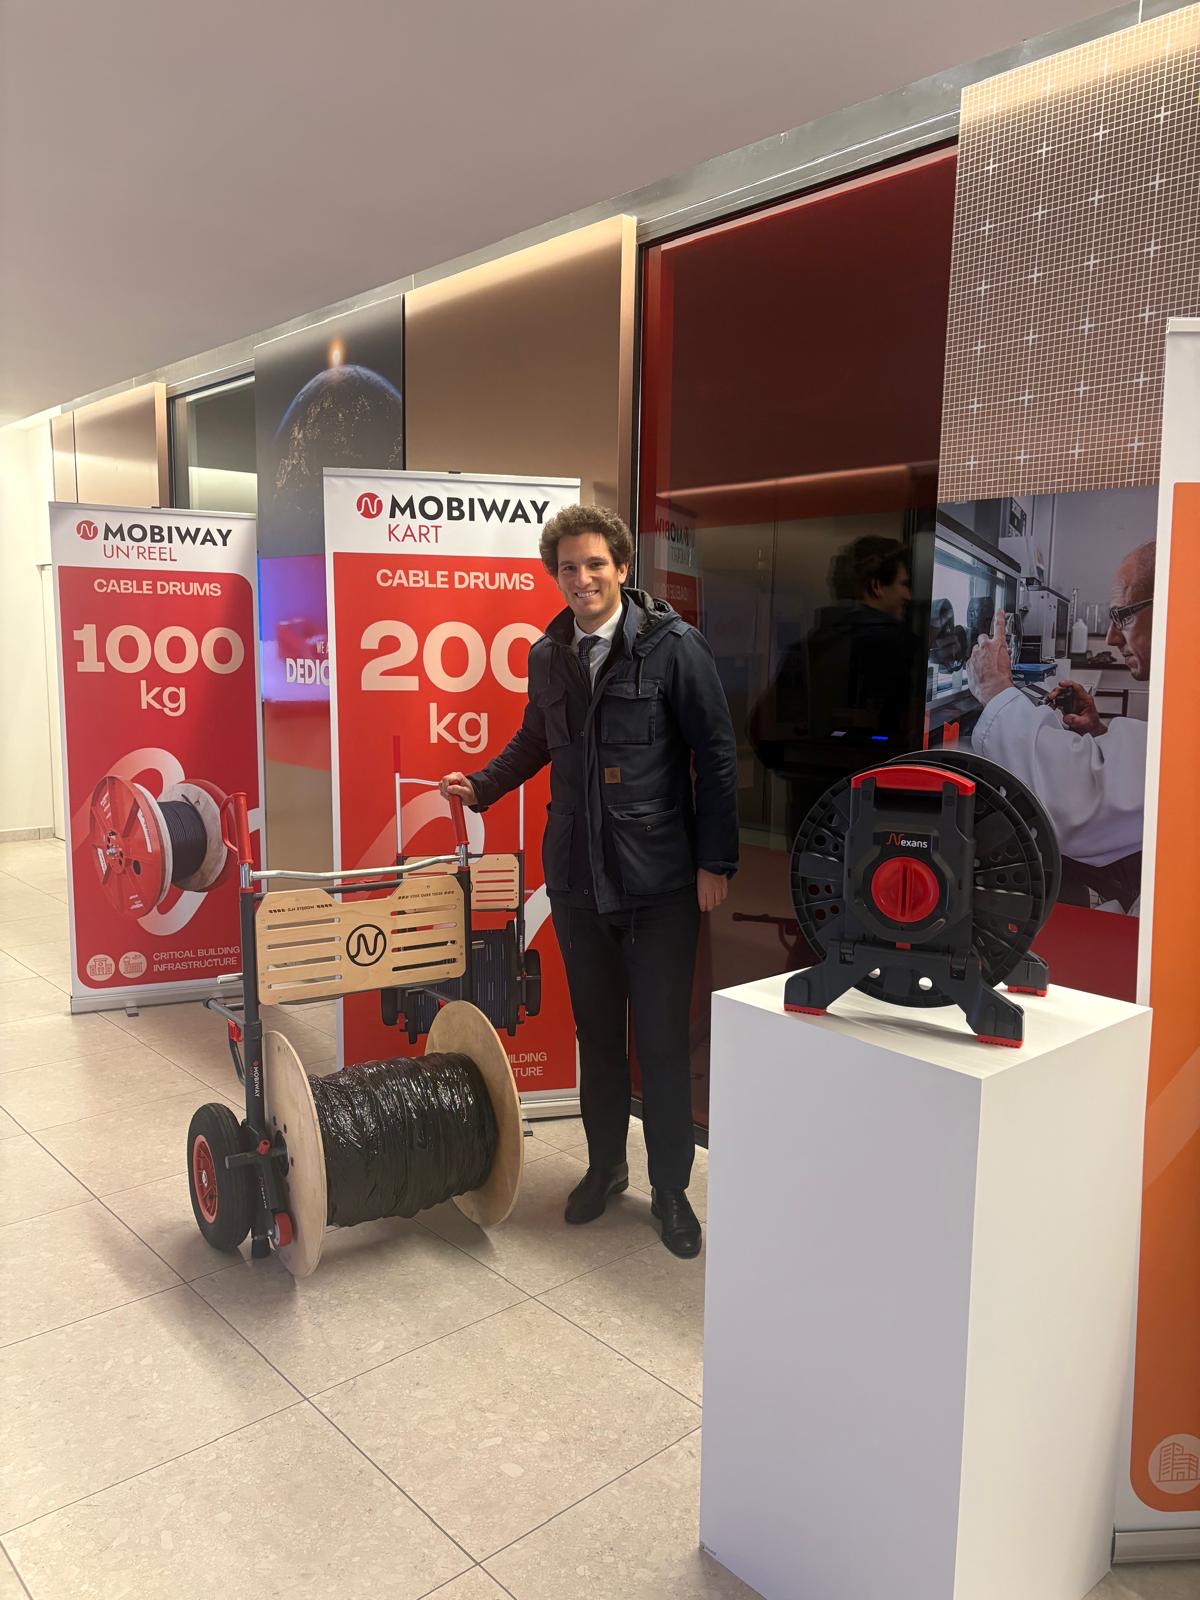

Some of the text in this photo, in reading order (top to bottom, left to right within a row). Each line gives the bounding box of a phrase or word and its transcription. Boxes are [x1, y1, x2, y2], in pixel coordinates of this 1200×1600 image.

[388, 494, 550, 524] MOBIWAY
[103, 522, 232, 547] MOBIWAY
[388, 523, 443, 543] KART
[103, 544, 177, 561] UN'REEL
[93, 579, 222, 596] CABLE DRUMS
[376, 568, 535, 591] CABLE DRUMS
[73, 623, 245, 675] 1000
[360, 619, 546, 693] 200
[140, 679, 186, 717] kg
[429, 702, 489, 754] kg
[885, 831, 928, 849] Nexans
[152, 945, 241, 961] CRITICAL BUILDING
[152, 956, 238, 972] INFRASTRUCTURE
[508, 1051, 548, 1064] ILDING
